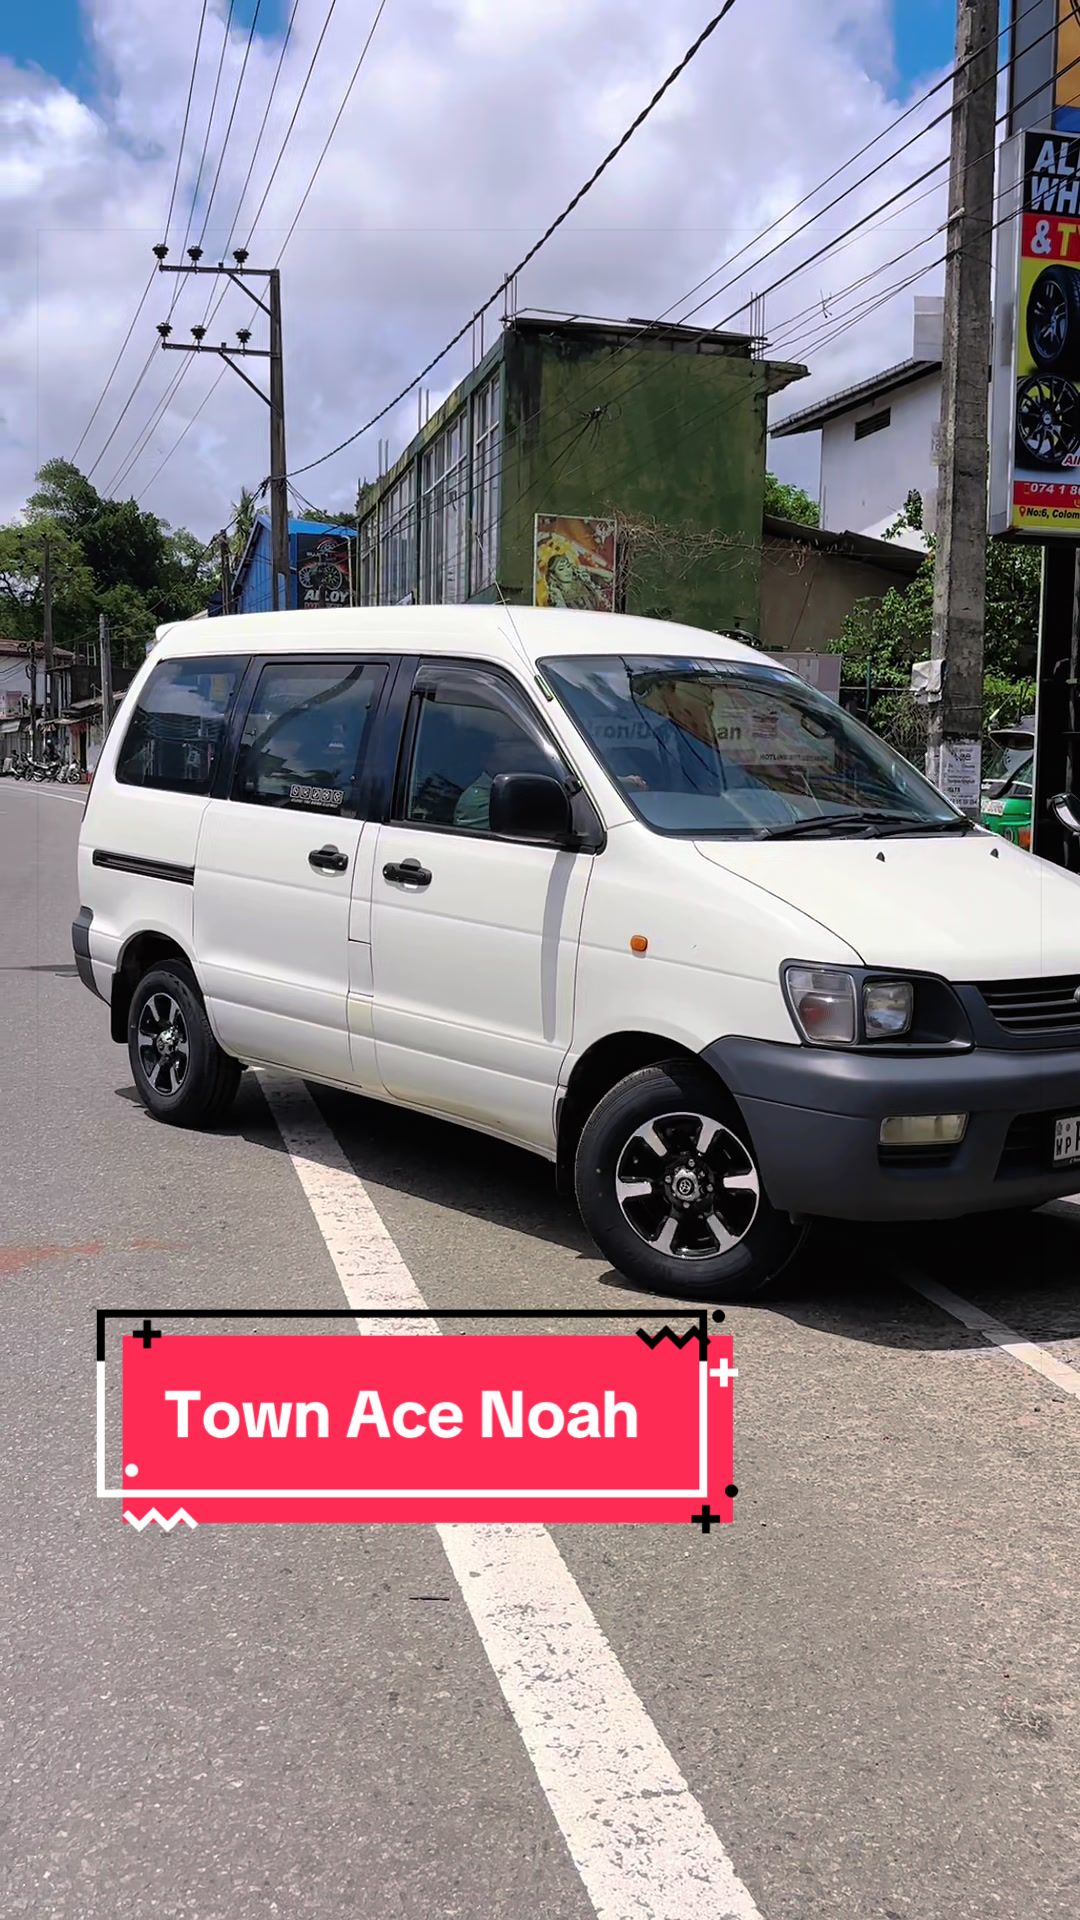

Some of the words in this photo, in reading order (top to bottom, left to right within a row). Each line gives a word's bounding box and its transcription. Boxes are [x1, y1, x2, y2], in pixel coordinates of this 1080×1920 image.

[1033, 140, 1080, 177] AL
[1031, 175, 1080, 215] WH
[1030, 219, 1052, 255] &
[1057, 222, 1080, 258] T
[1030, 483, 1055, 495] 074
